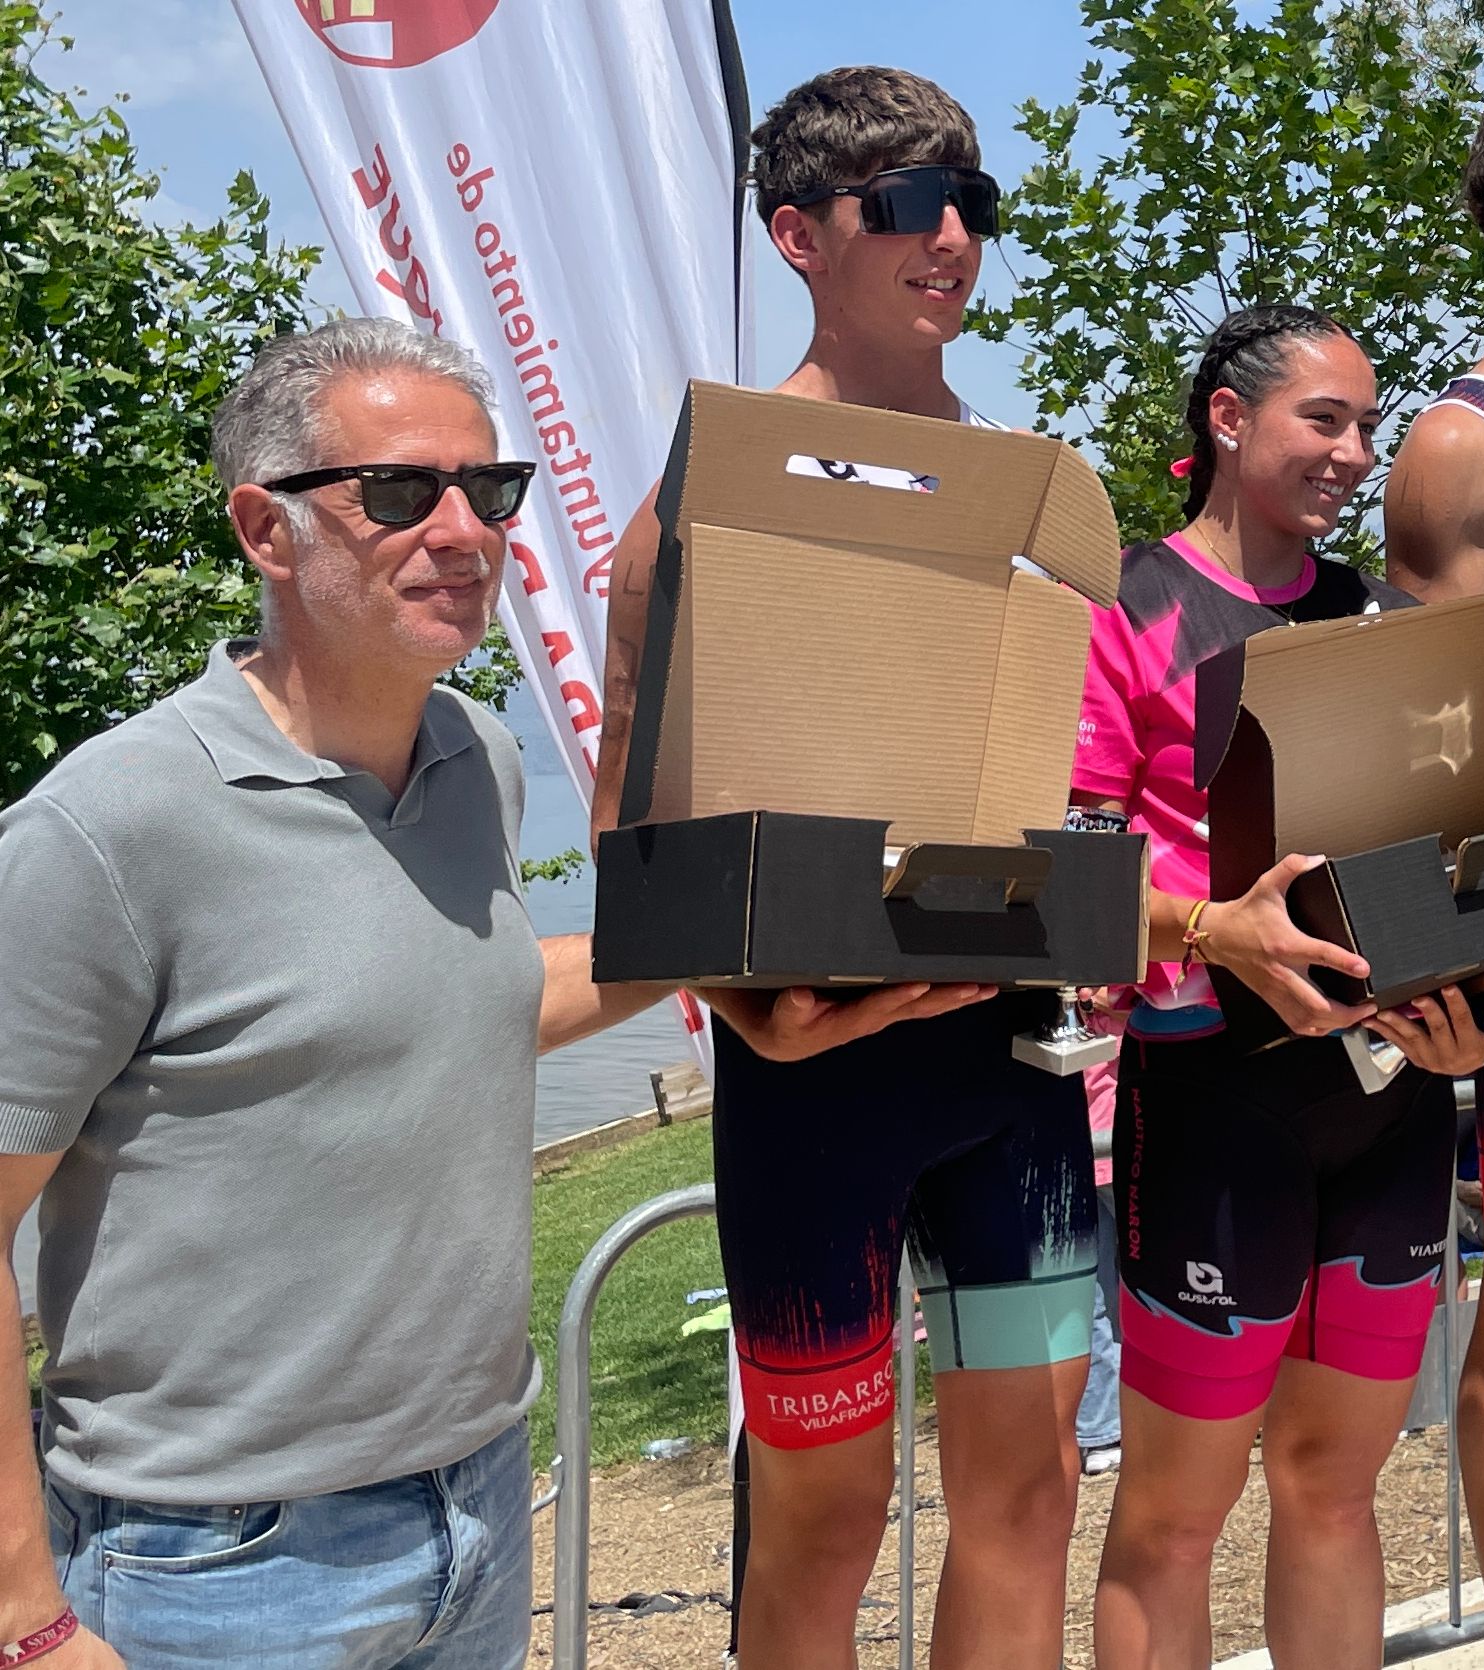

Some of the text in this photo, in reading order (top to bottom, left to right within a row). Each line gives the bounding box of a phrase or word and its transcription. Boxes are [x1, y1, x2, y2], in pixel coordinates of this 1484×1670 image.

[1177, 1291, 1238, 1306] austral
[766, 1359, 894, 1417] TRIBARRO
[799, 1388, 891, 1432] VILLAFRANCA
